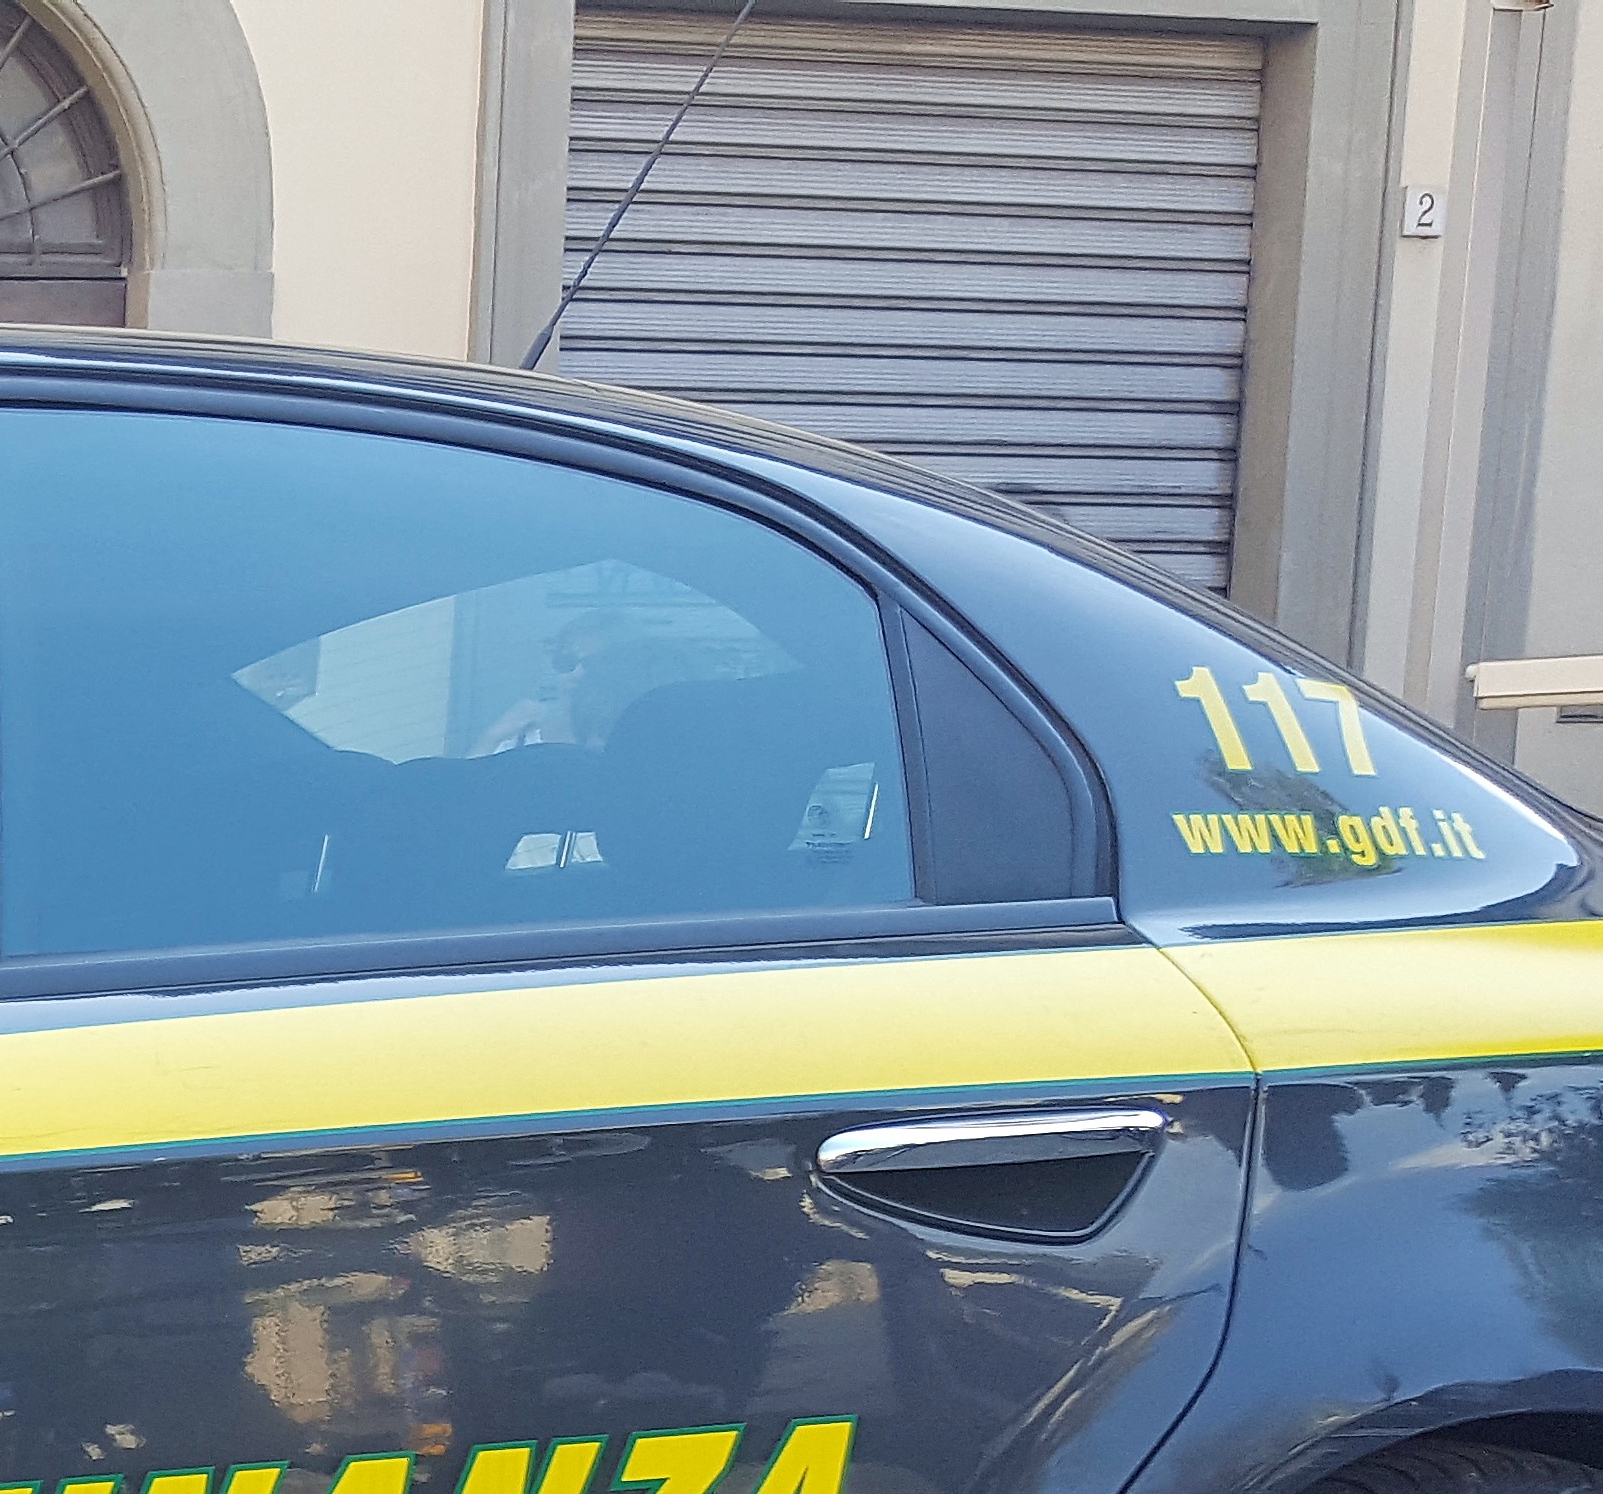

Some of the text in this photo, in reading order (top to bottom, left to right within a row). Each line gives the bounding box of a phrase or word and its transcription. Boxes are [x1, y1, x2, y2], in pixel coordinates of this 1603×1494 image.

[1415, 192, 1435, 228] 2
[1174, 666, 1378, 777] 117
[1172, 804, 1487, 868] www.gdf.it
